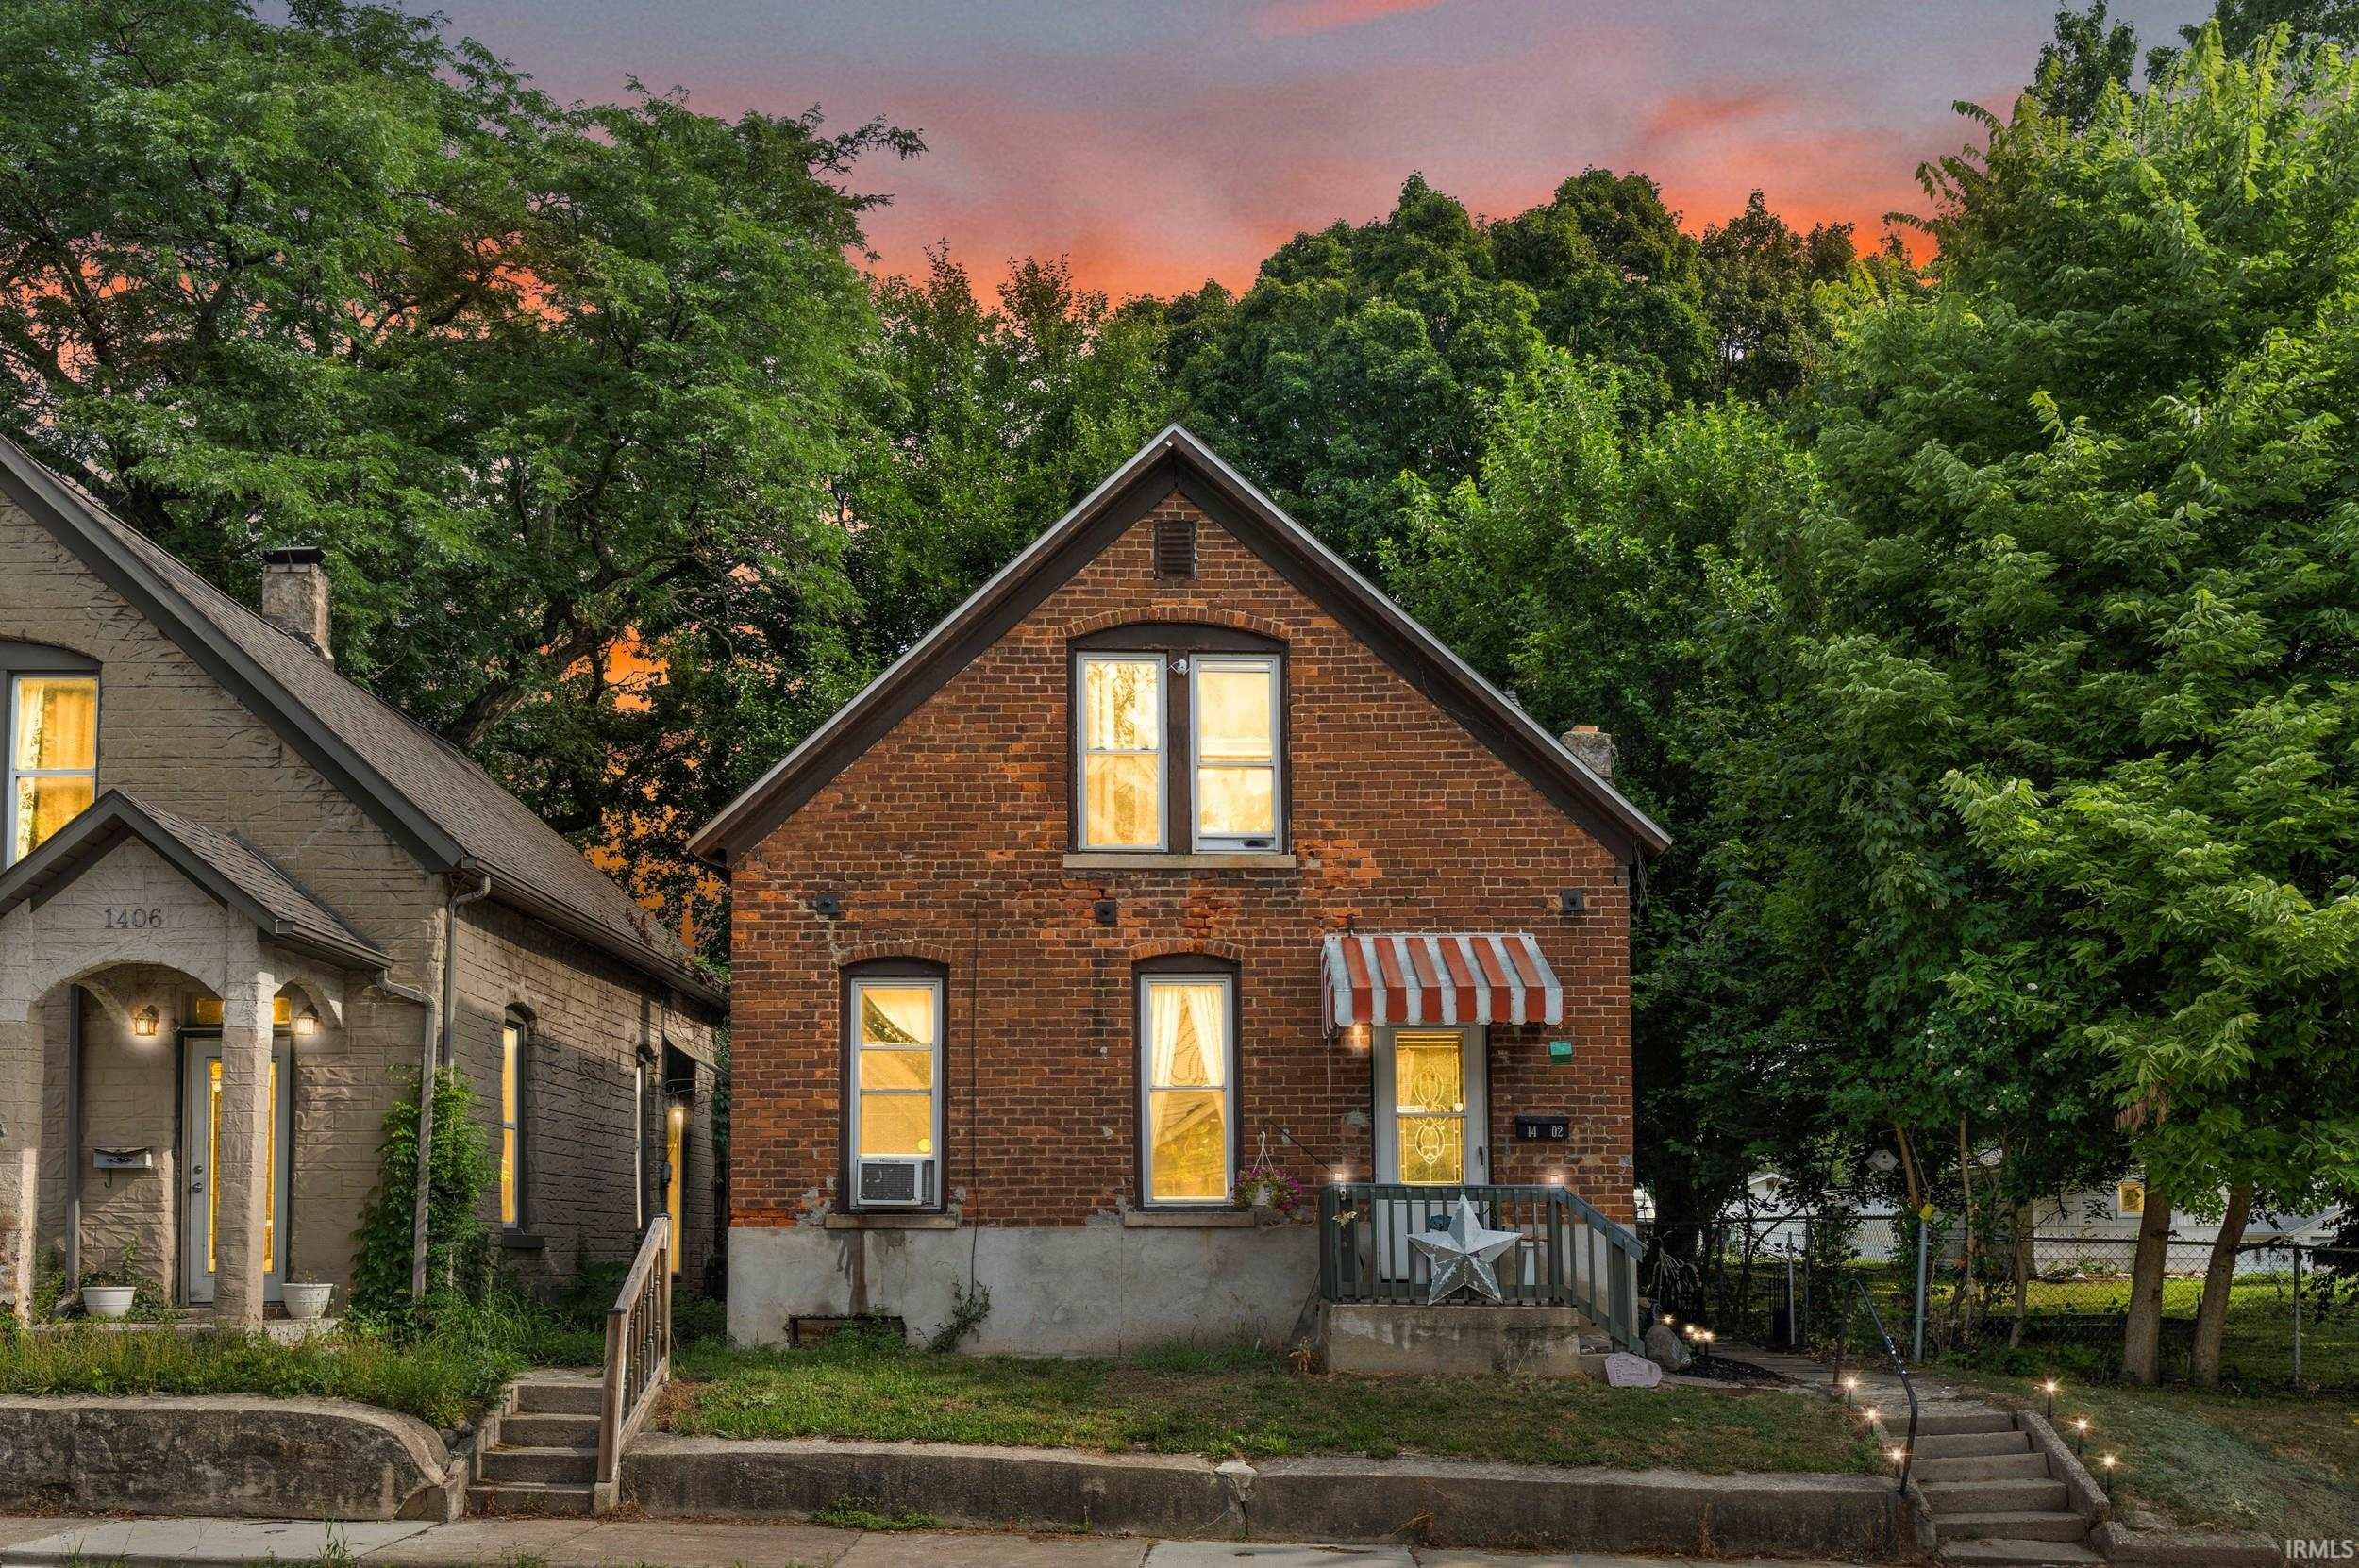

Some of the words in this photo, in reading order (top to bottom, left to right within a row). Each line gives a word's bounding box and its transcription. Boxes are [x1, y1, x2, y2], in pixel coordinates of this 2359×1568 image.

[105, 908, 162, 928] 1406
[1528, 1126, 1537, 1138] 14
[1551, 1126, 1564, 1138] 02
